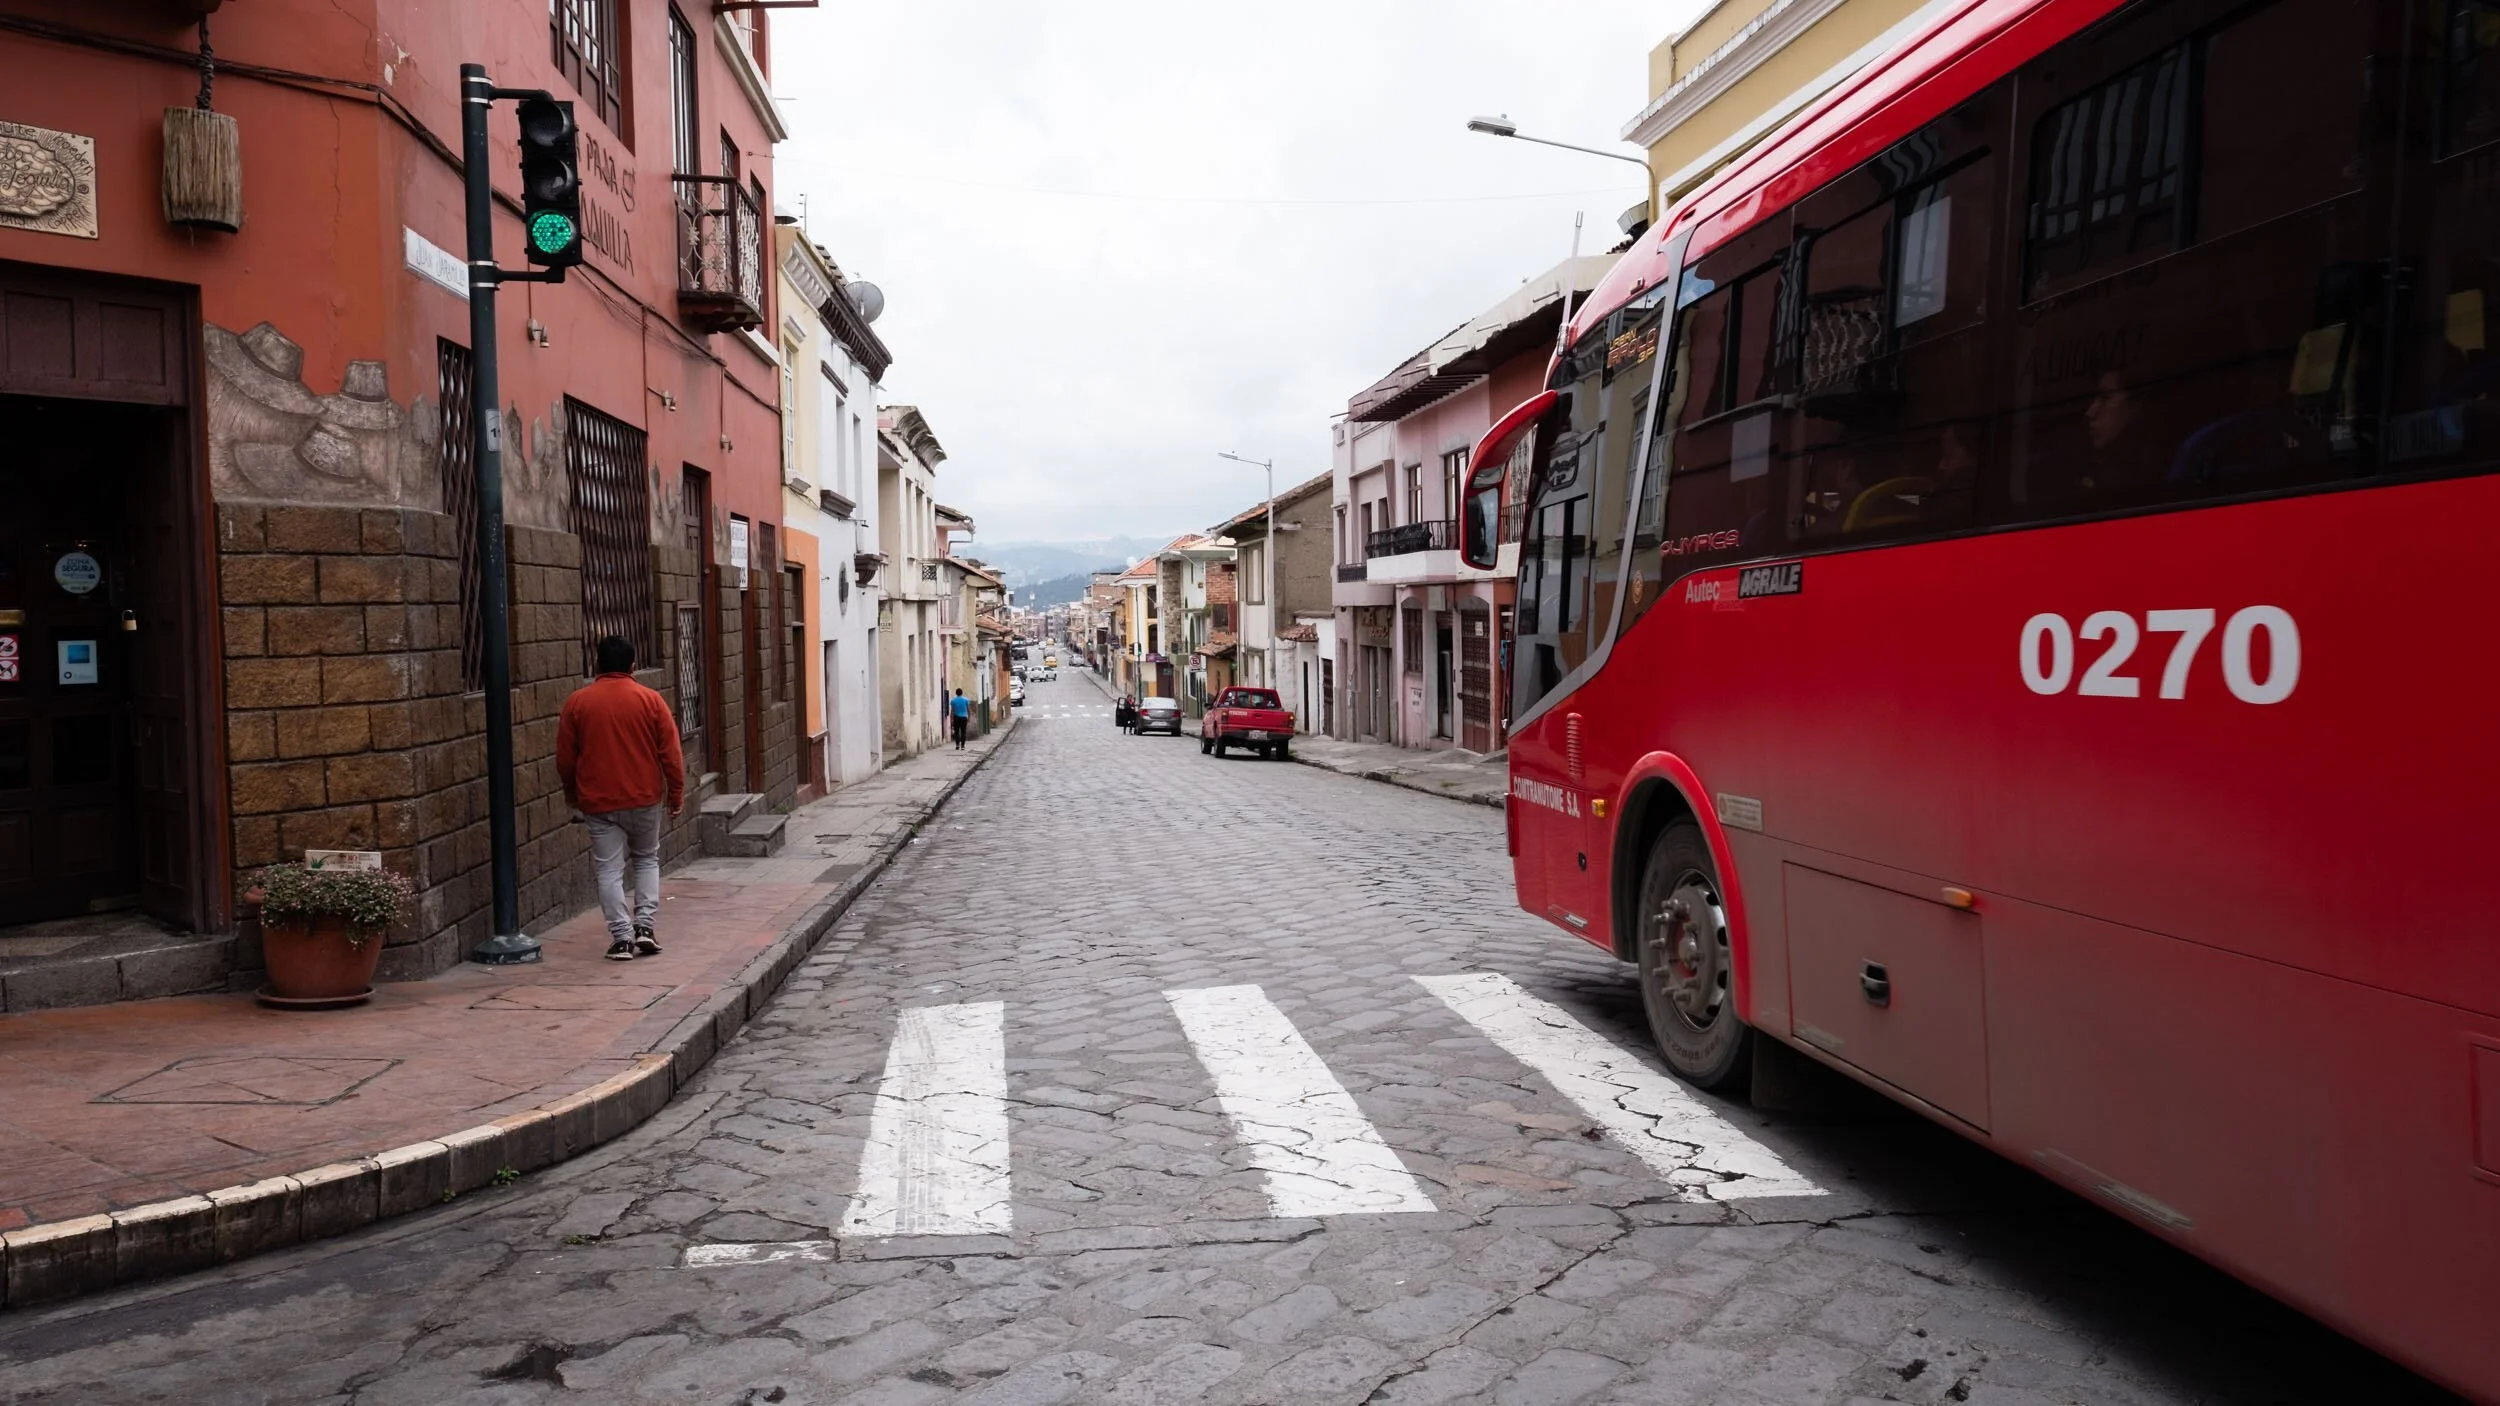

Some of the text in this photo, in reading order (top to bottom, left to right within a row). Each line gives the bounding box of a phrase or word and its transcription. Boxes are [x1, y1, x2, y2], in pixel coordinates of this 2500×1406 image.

[62, 564, 96, 572] SEGURA
[1685, 565, 1801, 604] Autec AGRALE
[2019, 605, 2302, 705] 0270
